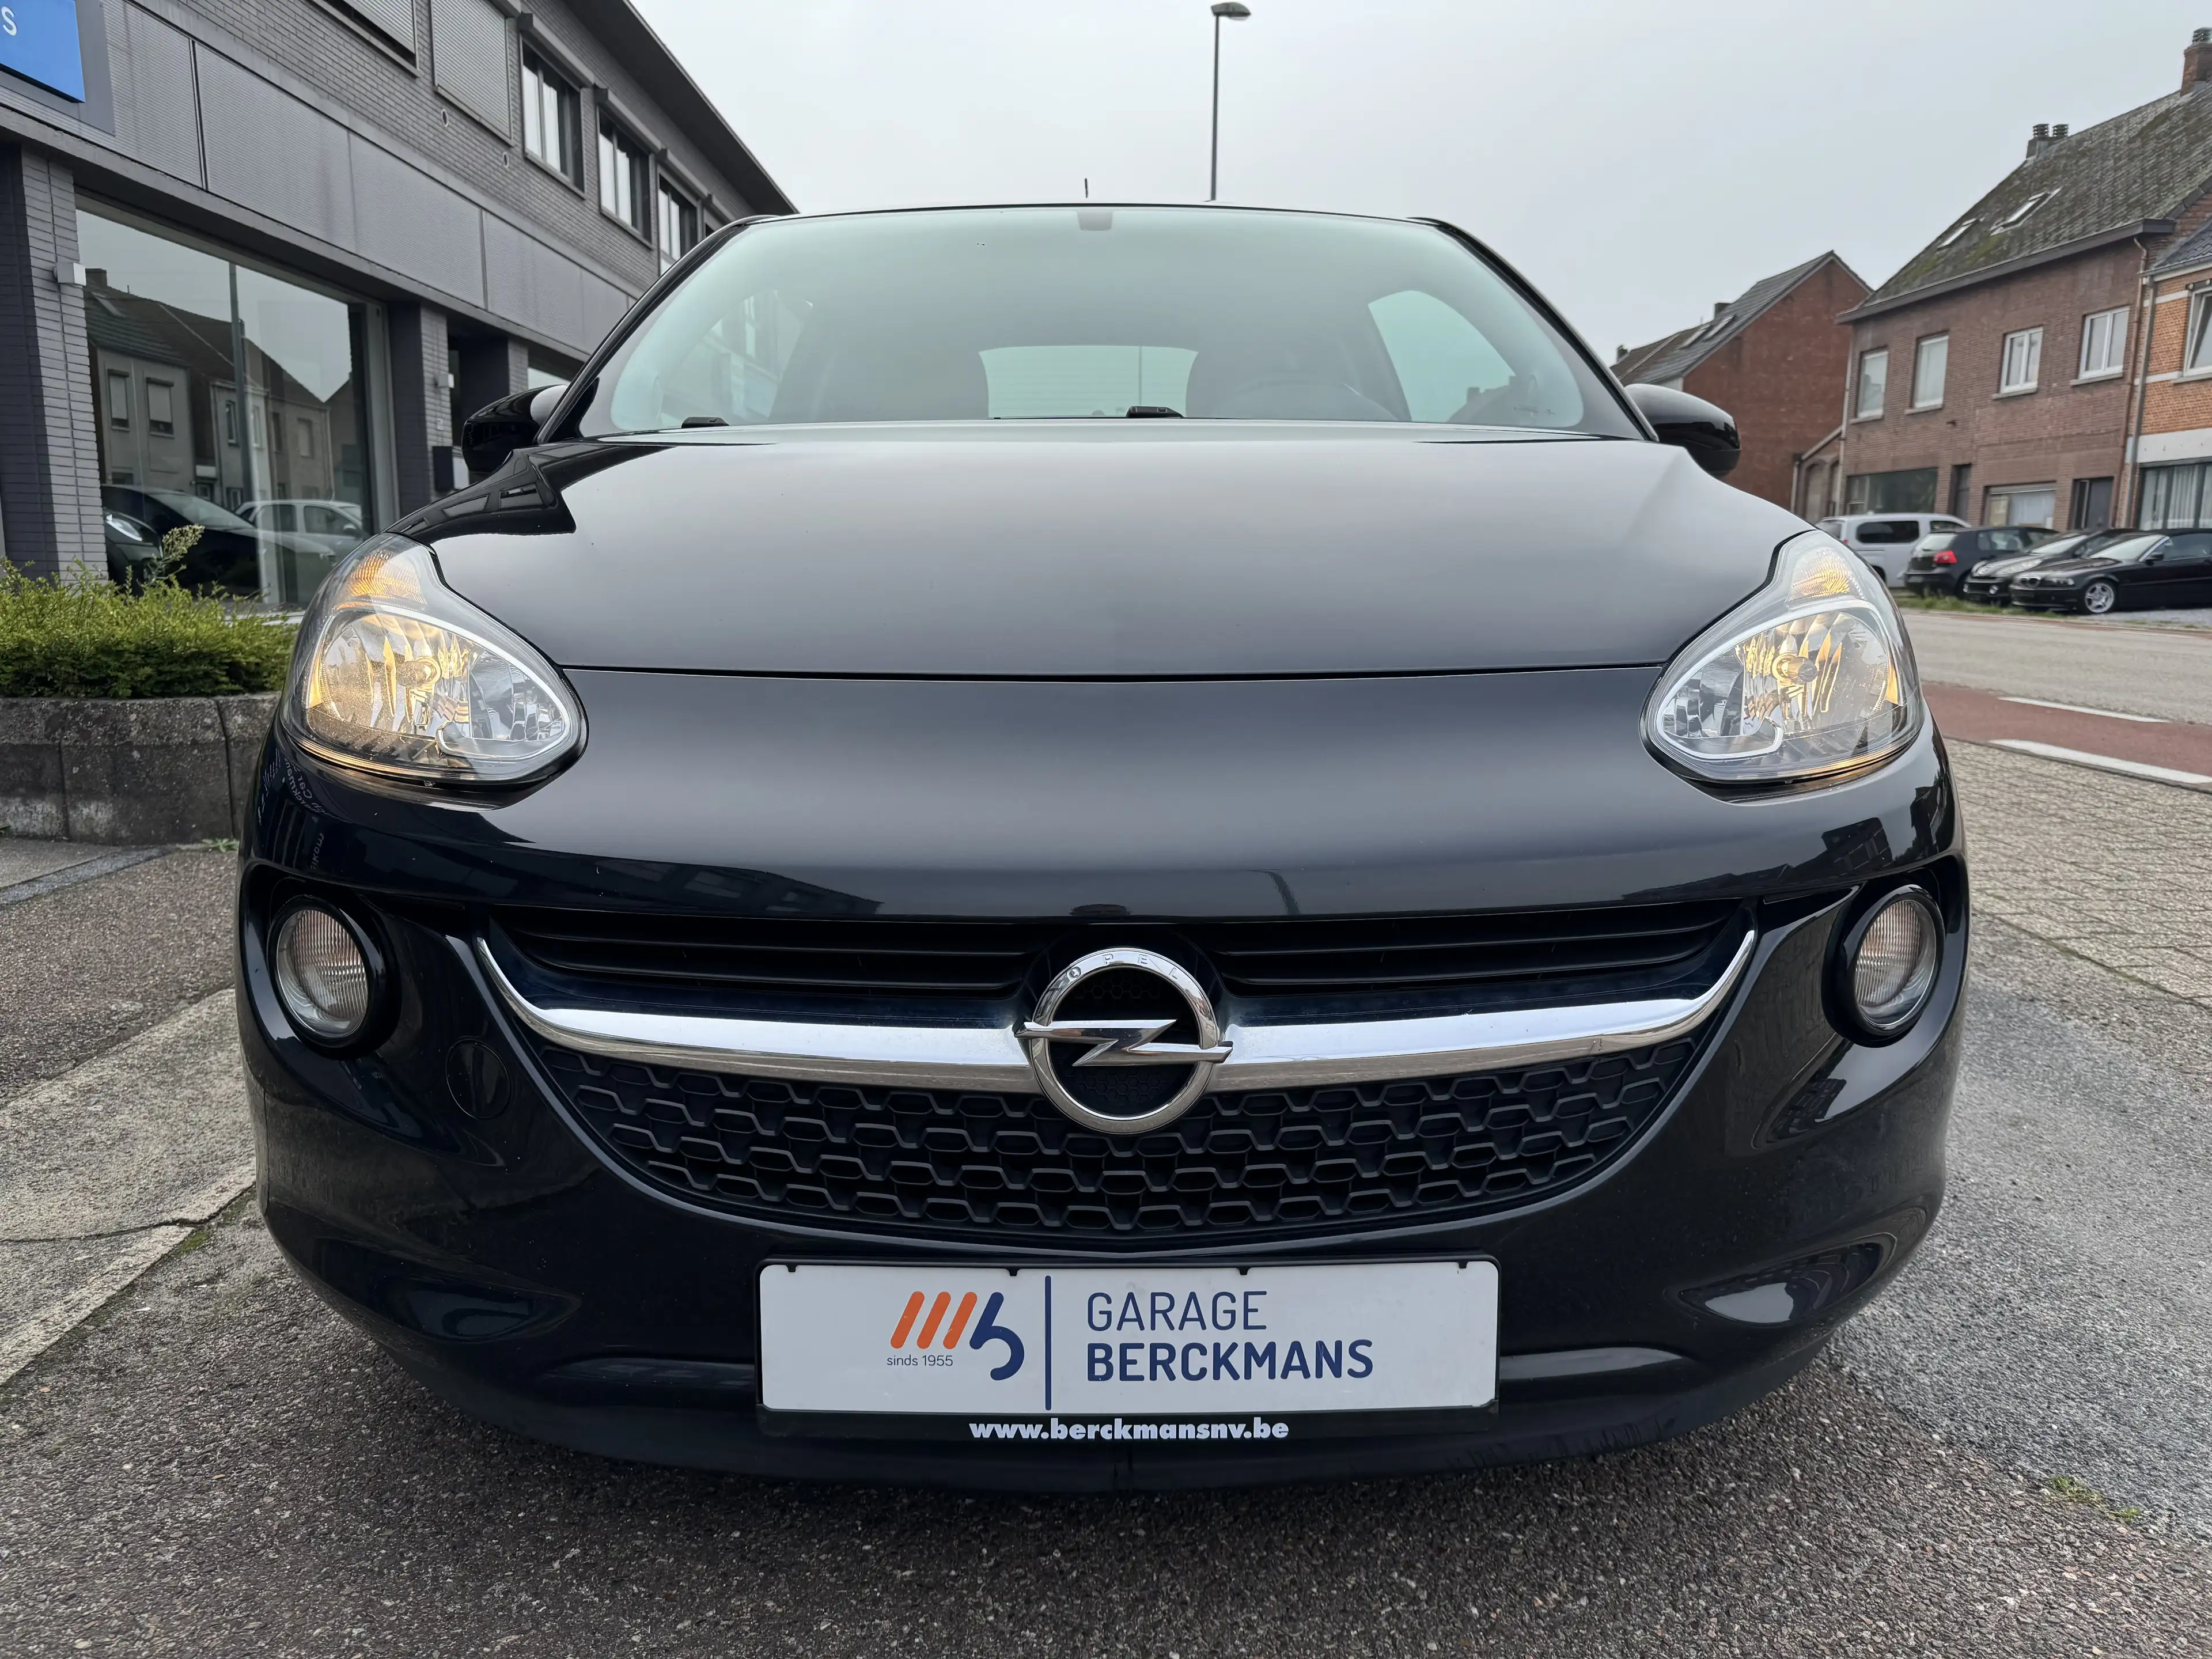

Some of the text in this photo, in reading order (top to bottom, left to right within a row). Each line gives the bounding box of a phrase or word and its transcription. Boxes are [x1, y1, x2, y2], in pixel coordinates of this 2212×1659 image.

[1066, 953, 1179, 981] OPEL
[1088, 1291, 1267, 1331] GARAGE
[887, 1354, 953, 1366] sinds 1955
[1088, 1339, 1373, 1381] BERCKMANS
[969, 1417, 1289, 1440] www.berckmansnv.be
